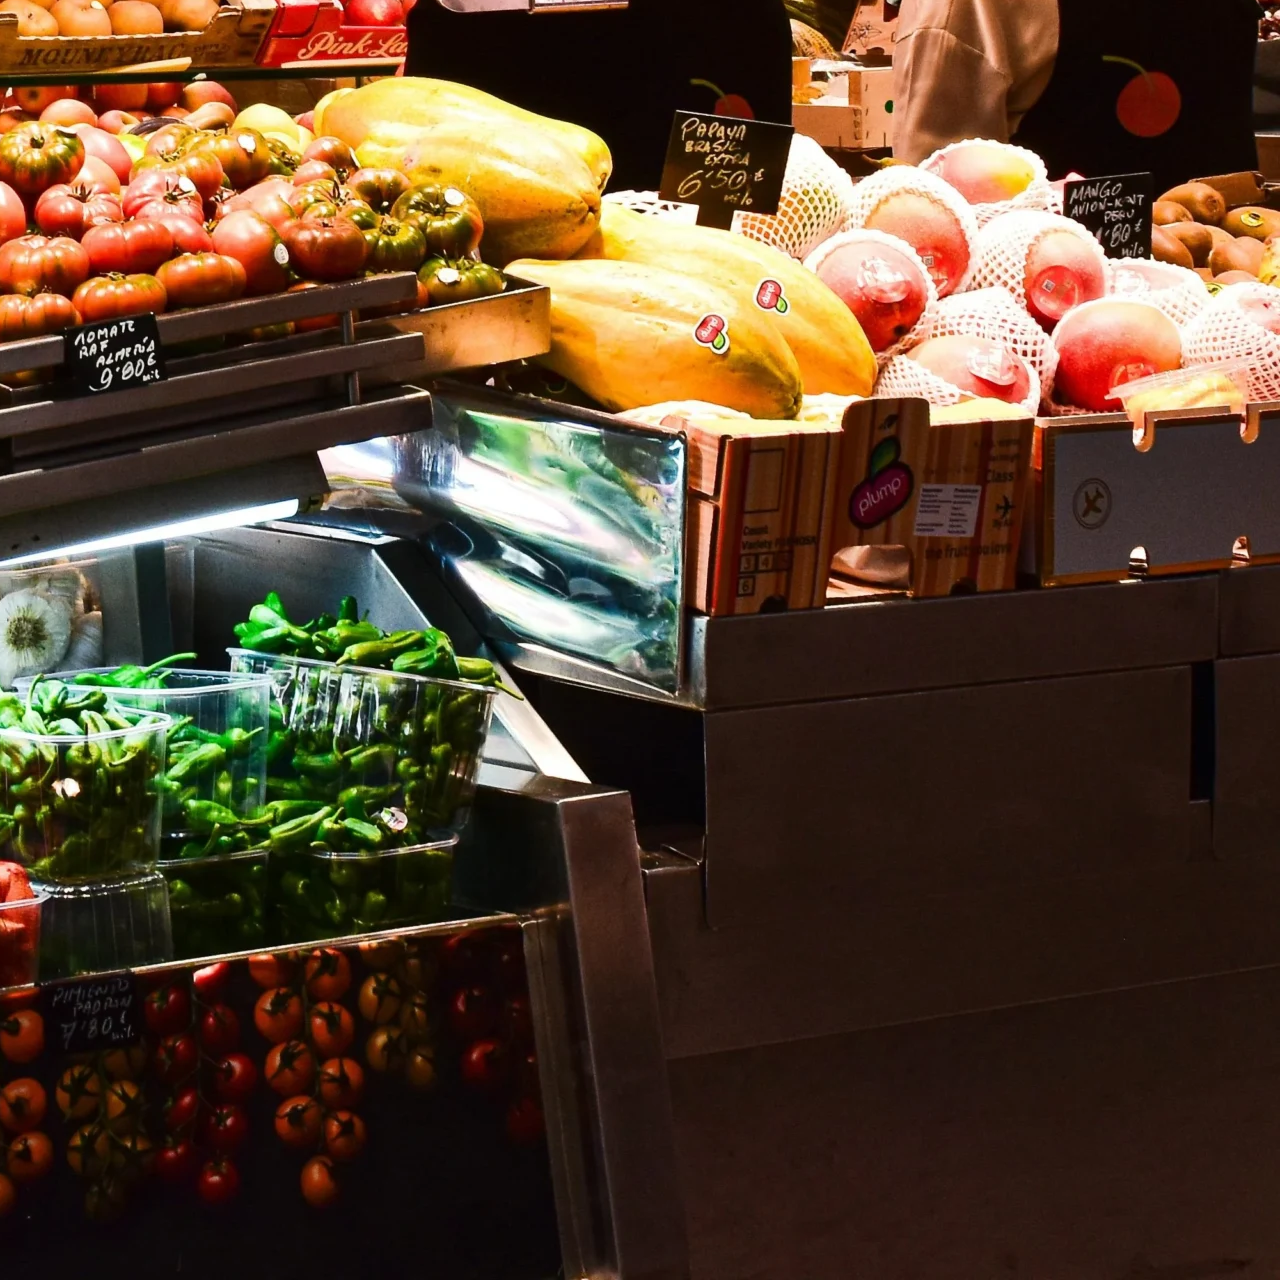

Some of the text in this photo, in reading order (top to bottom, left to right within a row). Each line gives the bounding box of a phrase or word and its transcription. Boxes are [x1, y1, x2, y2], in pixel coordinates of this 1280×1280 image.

[297, 31, 408, 59] Pink La
[681, 117, 747, 141] PAPAYA
[685, 140, 741, 152] BRASIL
[705, 152, 750, 166] EXTRA
[1069, 181, 1122, 204] MANGO
[1104, 209, 1135, 223] PERU
[74, 320, 135, 346] TOMATE
[79, 339, 109, 359] RAF
[859, 478, 901, 516] plump
